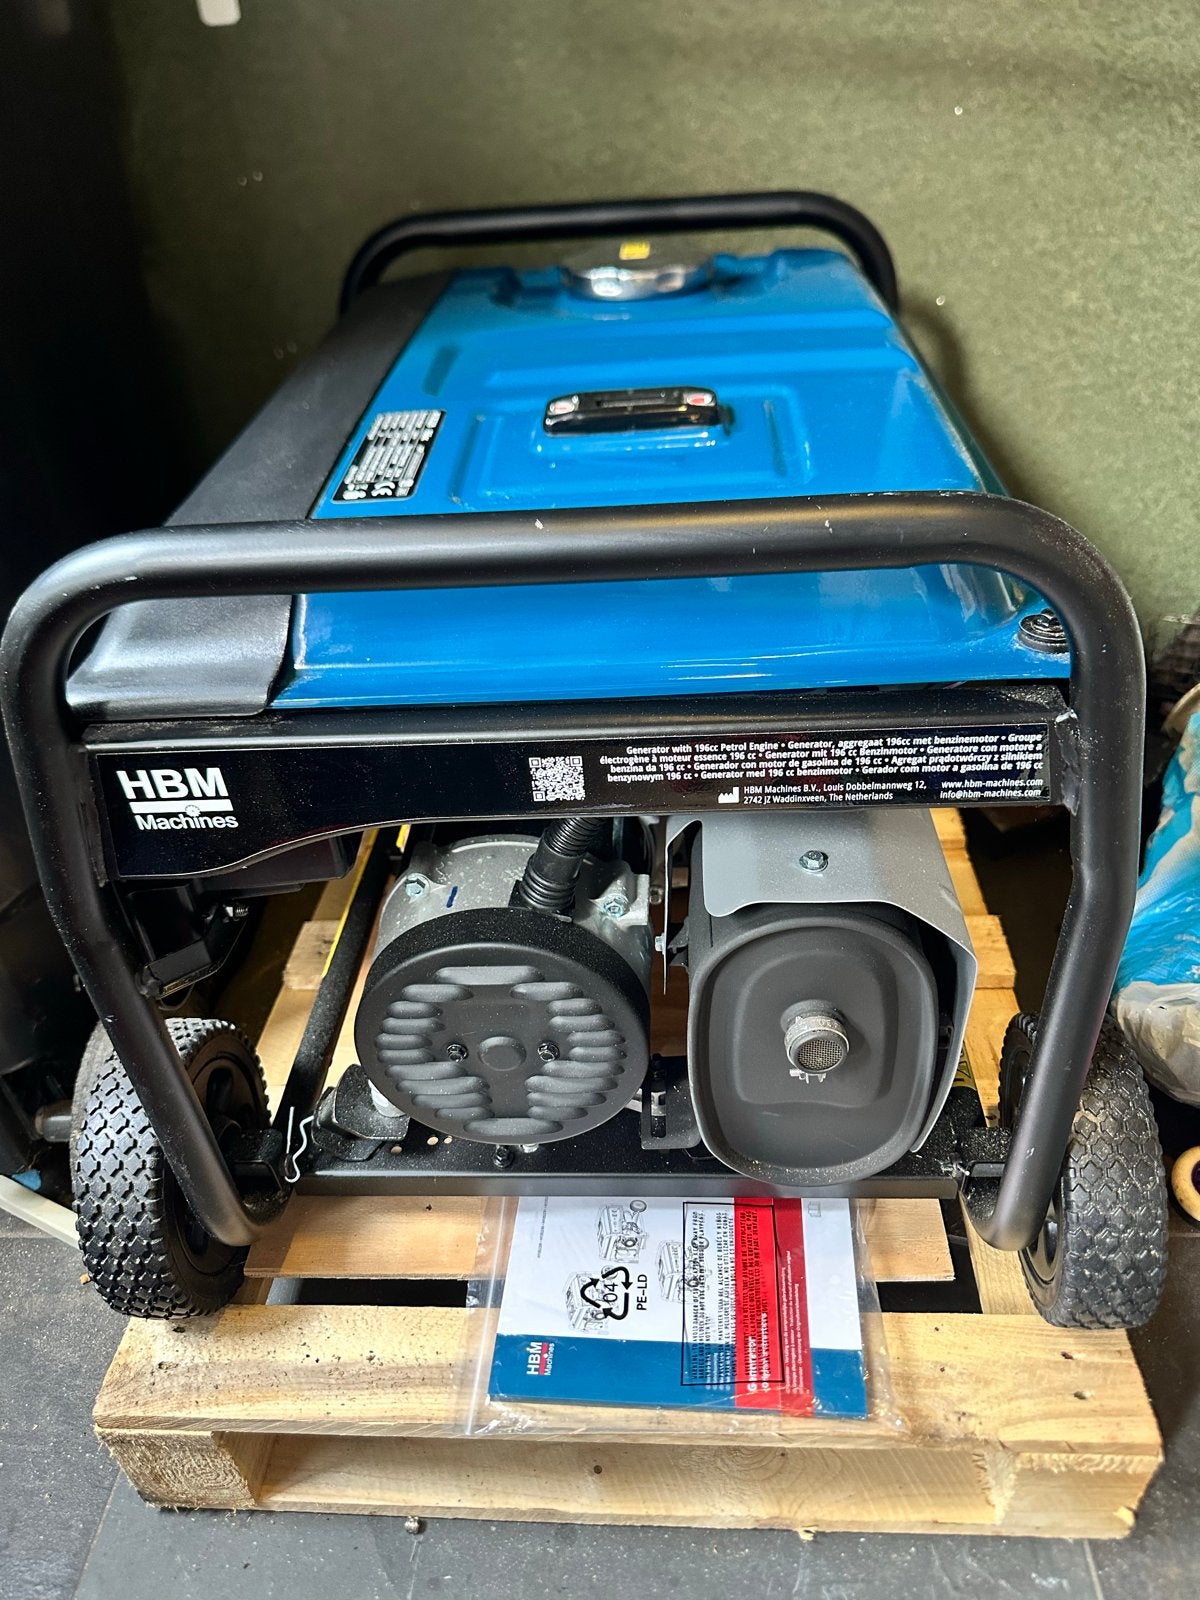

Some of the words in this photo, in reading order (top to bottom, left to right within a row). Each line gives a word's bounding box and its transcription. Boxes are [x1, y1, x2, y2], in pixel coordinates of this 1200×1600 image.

[626, 746, 669, 754] Generator
[672, 744, 692, 754] with
[694, 744, 718, 752] 196cc
[720, 742, 746, 752] Petrol
[750, 742, 778, 752] Engine
[788, 740, 836, 750] Generator,
[838, 739, 883, 749] aggregaat
[886, 737, 911, 746] 196cc
[912, 736, 932, 746] met
[934, 734, 1000, 745] benzinemotor
[1008, 734, 1042, 744] Groupe
[600, 755, 650, 766] électrogène
[652, 754, 658, 762] à
[660, 754, 691, 762] moteur
[694, 753, 727, 761] essence
[730, 752, 745, 760] 196
[766, 750, 808, 759] Generator
[812, 750, 828, 758] mit
[830, 748, 846, 757] 196
[860, 746, 918, 756] Benzinmotor
[926, 744, 978, 754] Generatore
[1000, 744, 1034, 752] motore
[610, 764, 644, 773] benzina
[646, 764, 656, 772] da
[659, 764, 674, 772] 196
[694, 762, 739, 770] Generador
[759, 760, 786, 768] motor
[788, 759, 800, 768] de
[802, 758, 838, 768] gasolina
[840, 757, 852, 766] de
[855, 756, 871, 765] 196
[891, 756, 926, 765] Agregat
[1000, 752, 1042, 760] silnikiem
[608, 773, 664, 783] benzynowym
[666, 772, 681, 780] 196
[700, 770, 744, 780] Generator
[746, 768, 766, 778] med
[768, 768, 784, 776] 196
[796, 766, 854, 776] benzinmotor
[862, 765, 898, 774] Gerador
[900, 765, 920, 773] com
[922, 764, 951, 773] motor
[960, 762, 998, 774] gasolina
[1000, 762, 1013, 770] de
[1016, 761, 1032, 770] 196
[116, 767, 229, 799] HBM
[744, 786, 762, 794] HBM
[764, 784, 801, 793] Machines
[804, 784, 822, 793] B.V.,
[824, 782, 844, 792] Louis
[846, 781, 912, 790] Dobbelmannweg
[914, 780, 926, 789] 12,
[940, 788, 1042, 799] info@hbm-machines.com
[942, 778, 1044, 788] www.hbm-machines.com
[744, 796, 762, 804] 2742
[764, 796, 772, 804] JZ
[772, 794, 827, 804] Waddinxveen,
[829, 792, 843, 802] The
[845, 792, 894, 801] Netherlands
[134, 813, 238, 830] Machines
[636, 1274, 648, 1311] PE-LD
[526, 1342, 542, 1375] HBM
[544, 1343, 555, 1376] Machines
